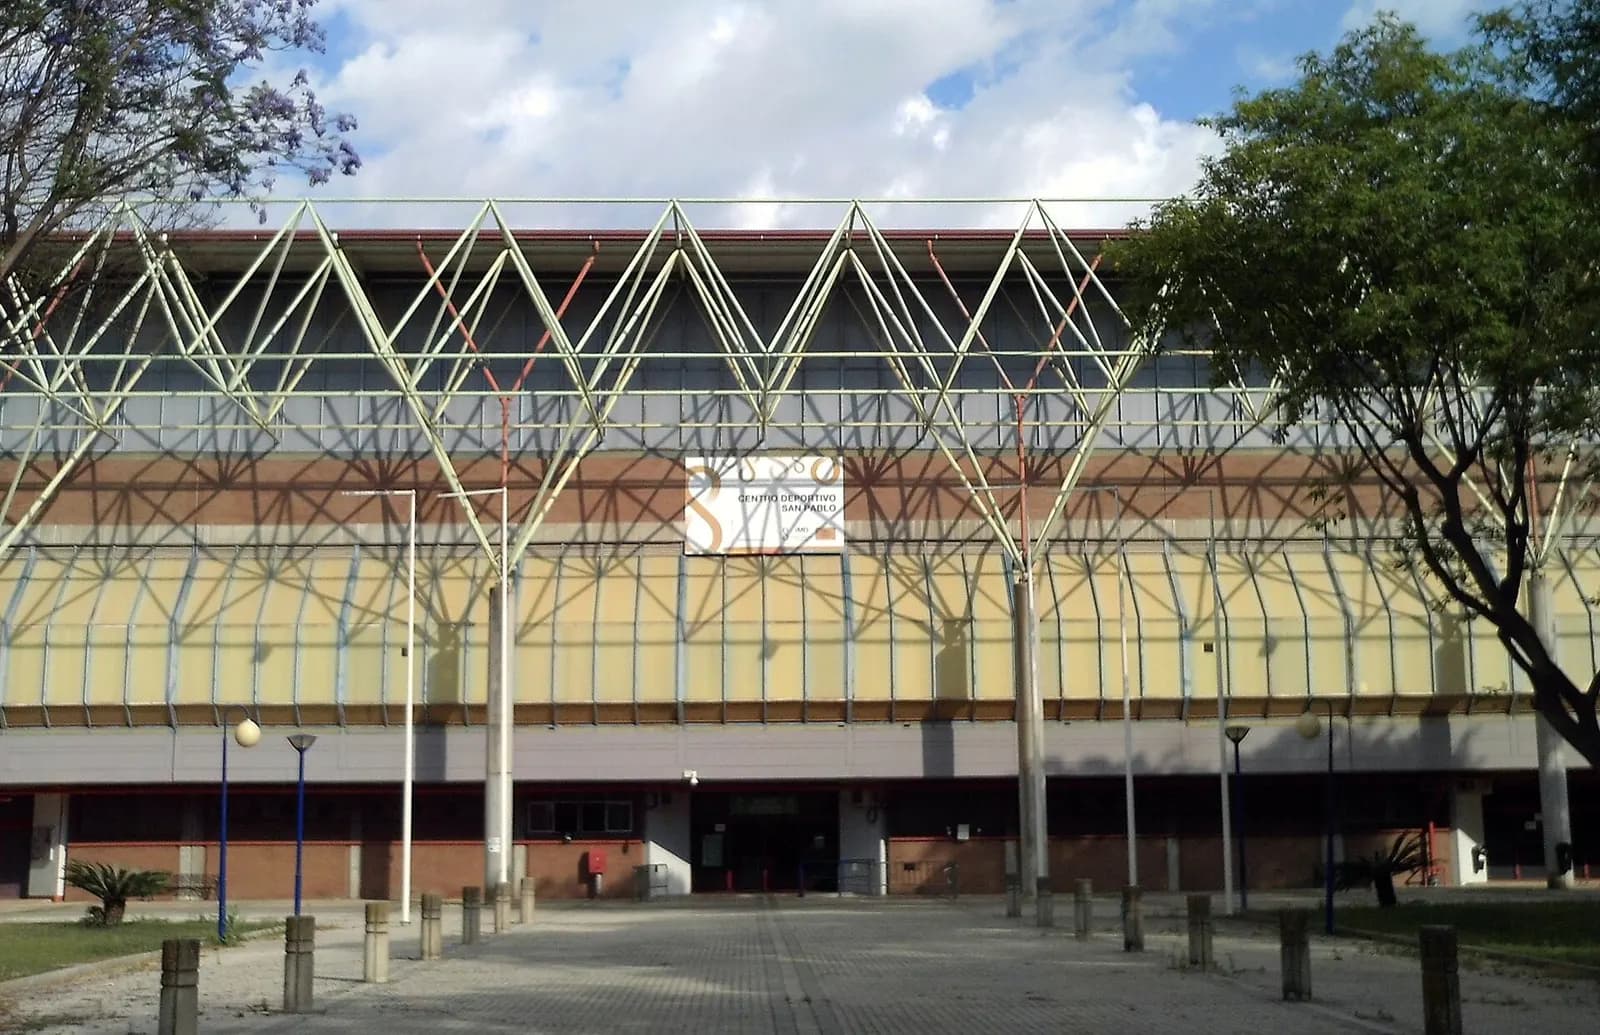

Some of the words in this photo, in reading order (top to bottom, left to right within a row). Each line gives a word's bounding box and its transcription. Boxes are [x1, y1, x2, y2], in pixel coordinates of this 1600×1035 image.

[738, 495, 778, 503] CENTRO
[780, 495, 837, 503] DEPORTIVO
[782, 504, 800, 512] SAN
[803, 504, 837, 512] PABLO
